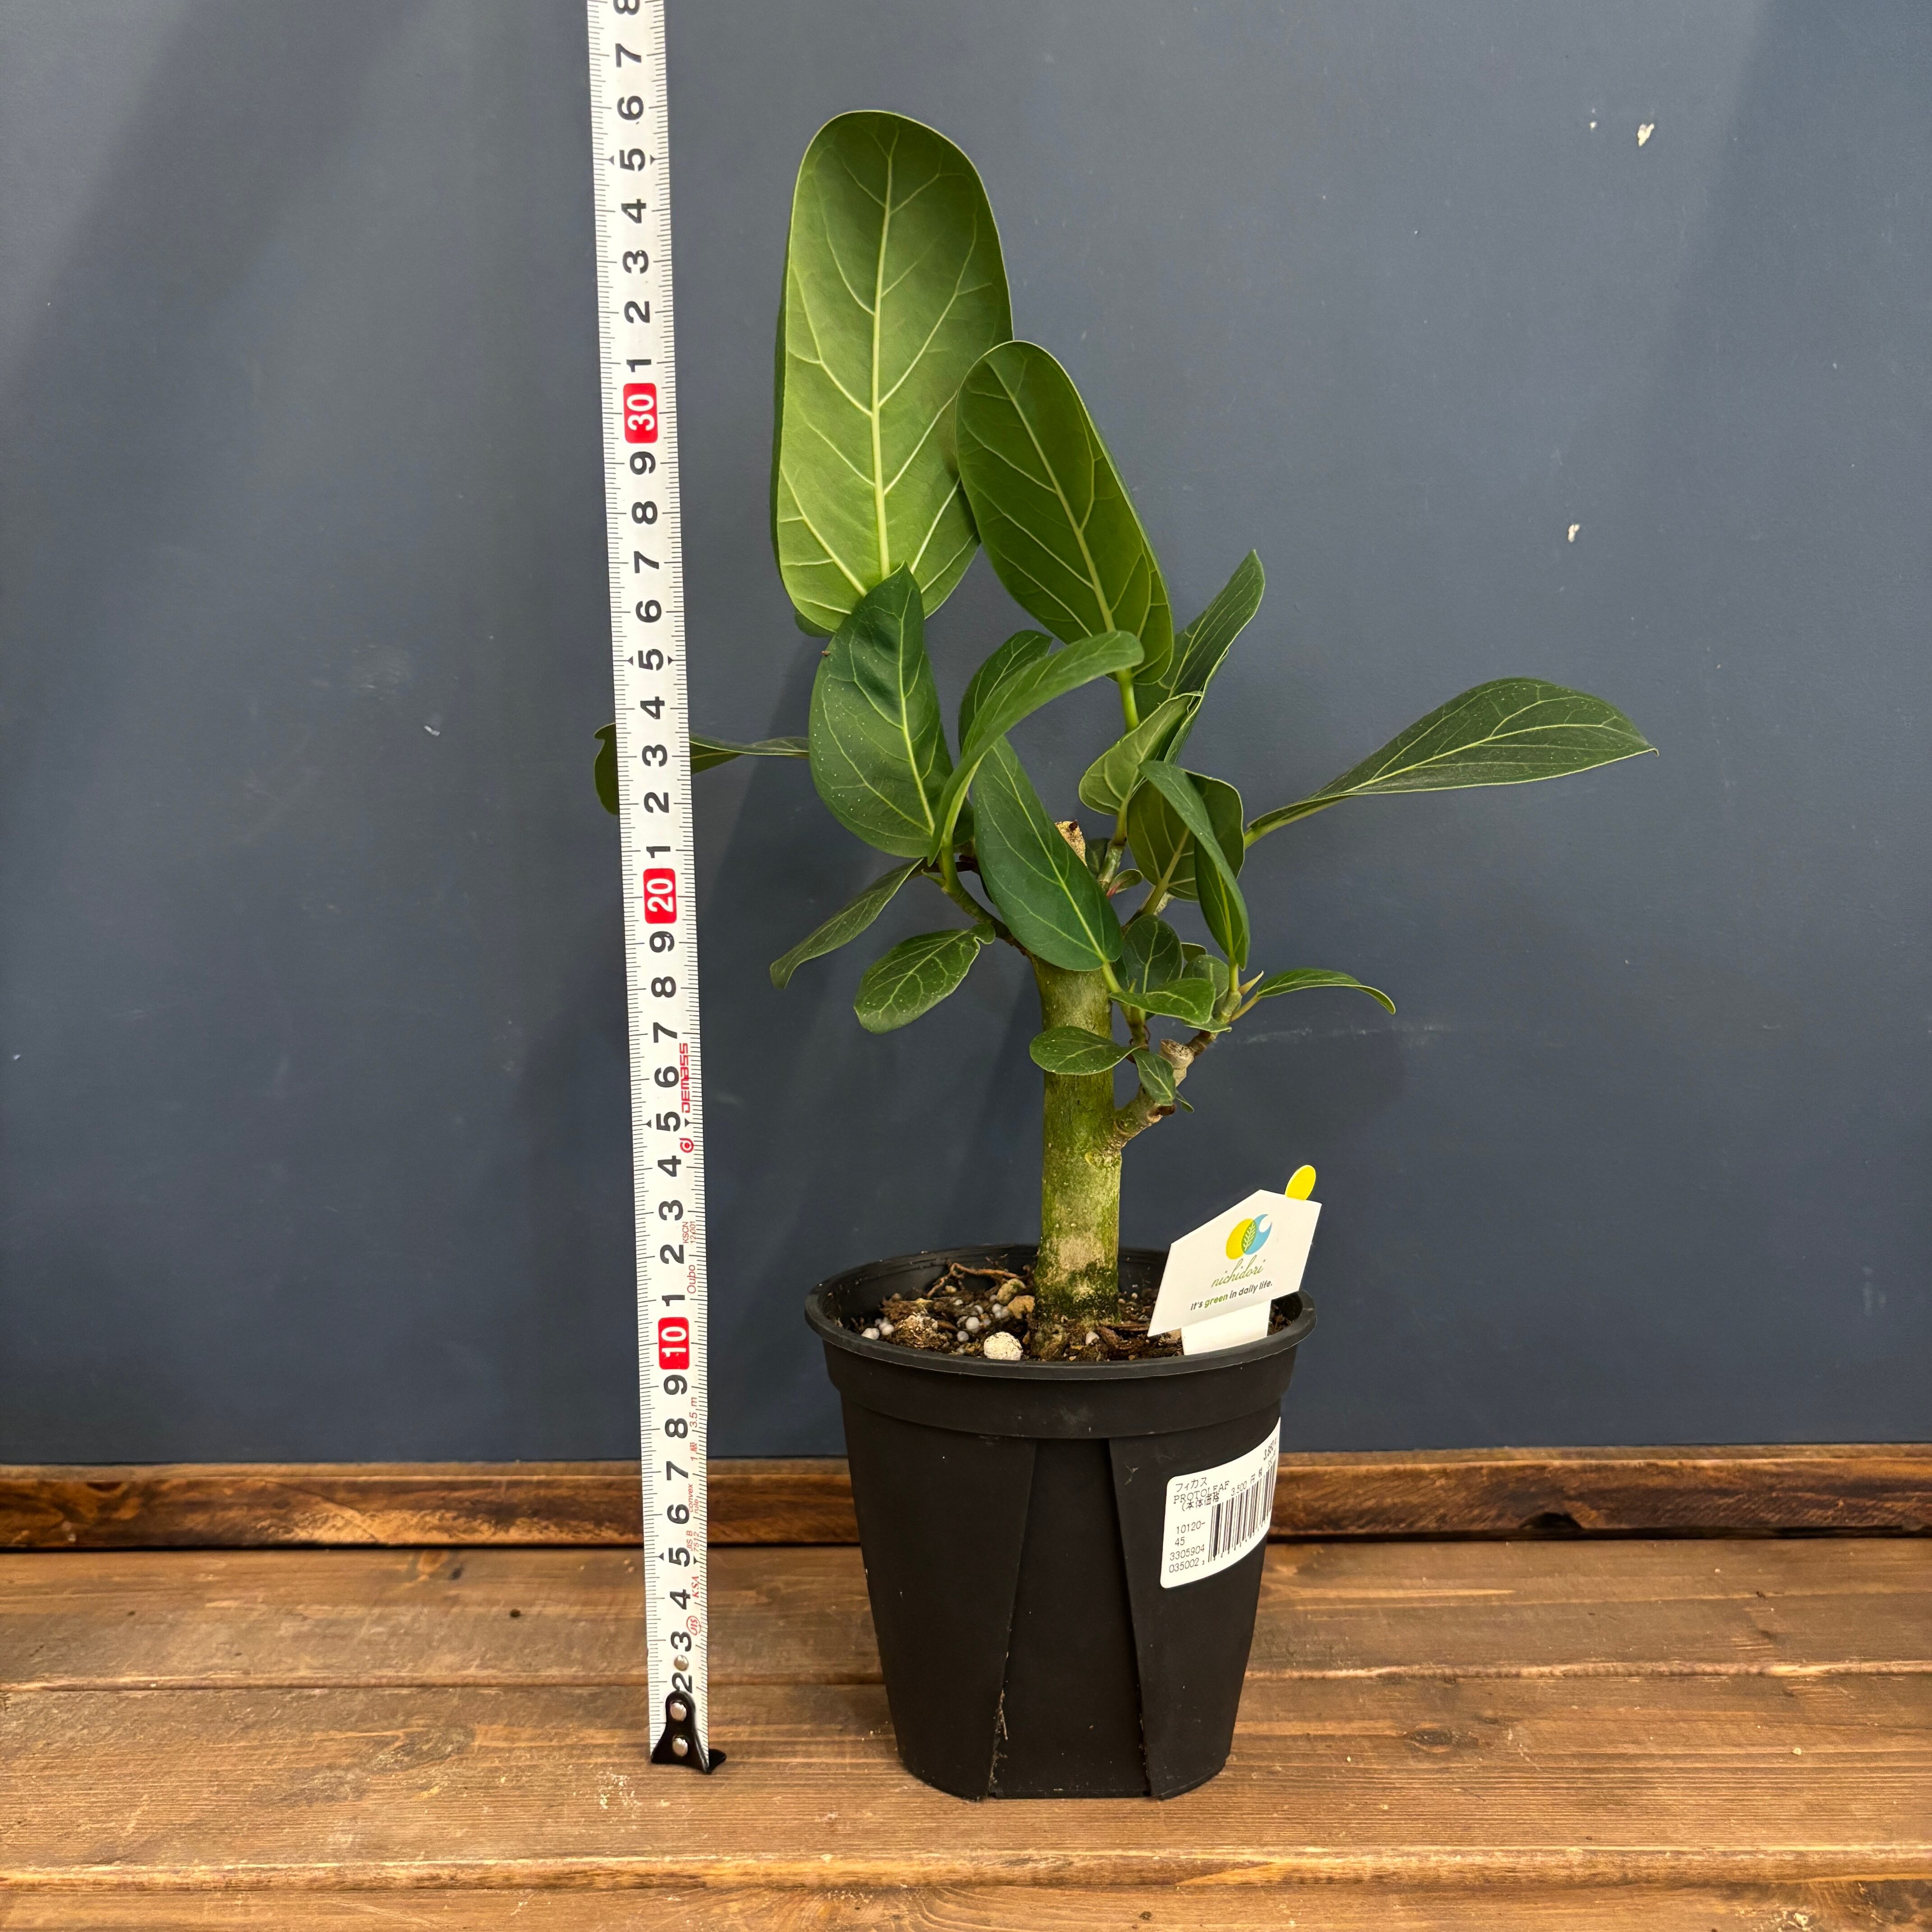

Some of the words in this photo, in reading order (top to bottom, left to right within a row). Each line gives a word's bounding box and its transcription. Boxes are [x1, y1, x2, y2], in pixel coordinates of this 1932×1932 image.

[616, 43, 642, 67] 7
[617, 96, 644, 120] 6
[619, 148, 645, 171] 5
[621, 198, 647, 224] 4
[622, 250, 649, 274] 3
[624, 301, 650, 323] 2
[626, 359, 652, 373] 1
[626, 394, 655, 431] 30
[630, 451, 656, 475] 9
[631, 501, 658, 525] 8
[634, 551, 659, 574] 7
[635, 599, 662, 623] 6
[638, 649, 664, 671] 5
[640, 696, 665, 720] 4
[642, 744, 668, 767] 3
[644, 792, 669, 813] 2
[646, 846, 671, 859] 1
[647, 878, 674, 912] 20
[649, 931, 675, 953] 9
[651, 976, 676, 998] 8
[653, 1022, 678, 1043] 7
[654, 1066, 679, 1088] 6
[656, 1111, 681, 1132] 5
[657, 1155, 681, 1177] 4
[658, 1200, 684, 1221] 3
[660, 1244, 685, 1264] 2
[687, 1265, 696, 1294] Oubo
[1210, 1255, 1265, 1288] nichidori
[662, 1294, 685, 1306] 1
[1190, 1301, 1203, 1311] It's
[1204, 1293, 1228, 1308] green
[1229, 1290, 1237, 1299] in
[1238, 1284, 1258, 1296] daily
[1259, 1280, 1273, 1290] life.
[661, 1326, 687, 1358] 10
[663, 1374, 688, 1395] 9
[664, 1418, 688, 1439] 8
[666, 1461, 689, 1481] 7
[1173, 1481, 1230, 1504] PROTOLEAF
[1175, 1477, 1207, 1492] フィカス
[667, 1504, 690, 1524] 6
[1176, 1520, 1205, 1534] 10120-
[1175, 1536, 1185, 1546] 45
[668, 1547, 690, 1567] 5
[1169, 1544, 1205, 1561] 3305904
[1169, 1557, 1200, 1573] 035002
[691, 1576, 699, 1598] KSA
[669, 1589, 691, 1610] 4
[670, 1631, 692, 1652] 3
[672, 1672, 693, 1694] 2
